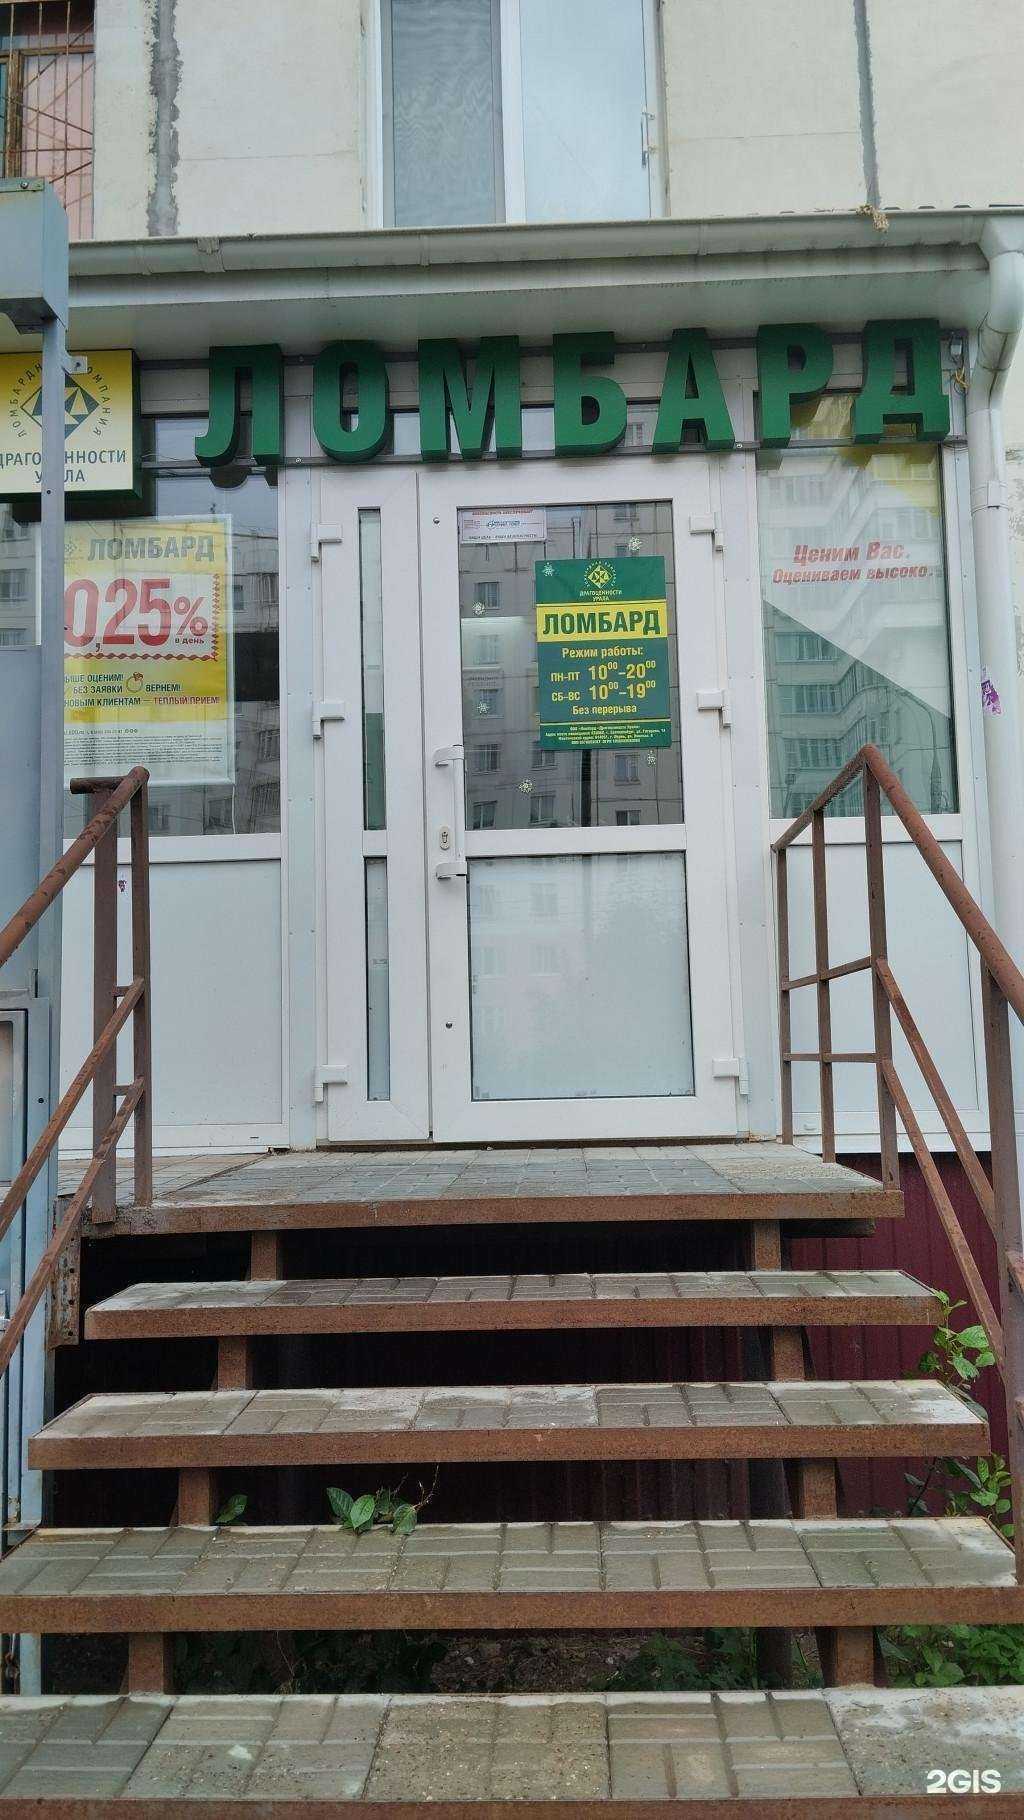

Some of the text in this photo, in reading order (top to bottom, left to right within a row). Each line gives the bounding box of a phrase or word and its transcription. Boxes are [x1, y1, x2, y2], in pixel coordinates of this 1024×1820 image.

[195, 318, 950, 467] ЛОМБАРД
[0, 450, 126, 468] РАГОННОСТИ
[35, 469, 85, 483] УЛА
[88, 535, 215, 561] ЛОМБАРД
[793, 541, 910, 566] Ценим Вас.
[772, 564, 934, 585] Оцениваем высоко.
[543, 609, 661, 635] ЛОМБАРД
[562, 646, 644, 658] Режим работы:
[65, 673, 124, 684] ЫШЕ ОЦЕНИМ!
[73, 683, 181, 694] БЕЗ ЗАЯВКИ ВЕРНЕМ!
[97, 697, 141, 707] КЛИЕНТАМ
[154, 695, 188, 705] ТЕПЛЫЙ
[572, 704, 637, 716] Без перерыва
